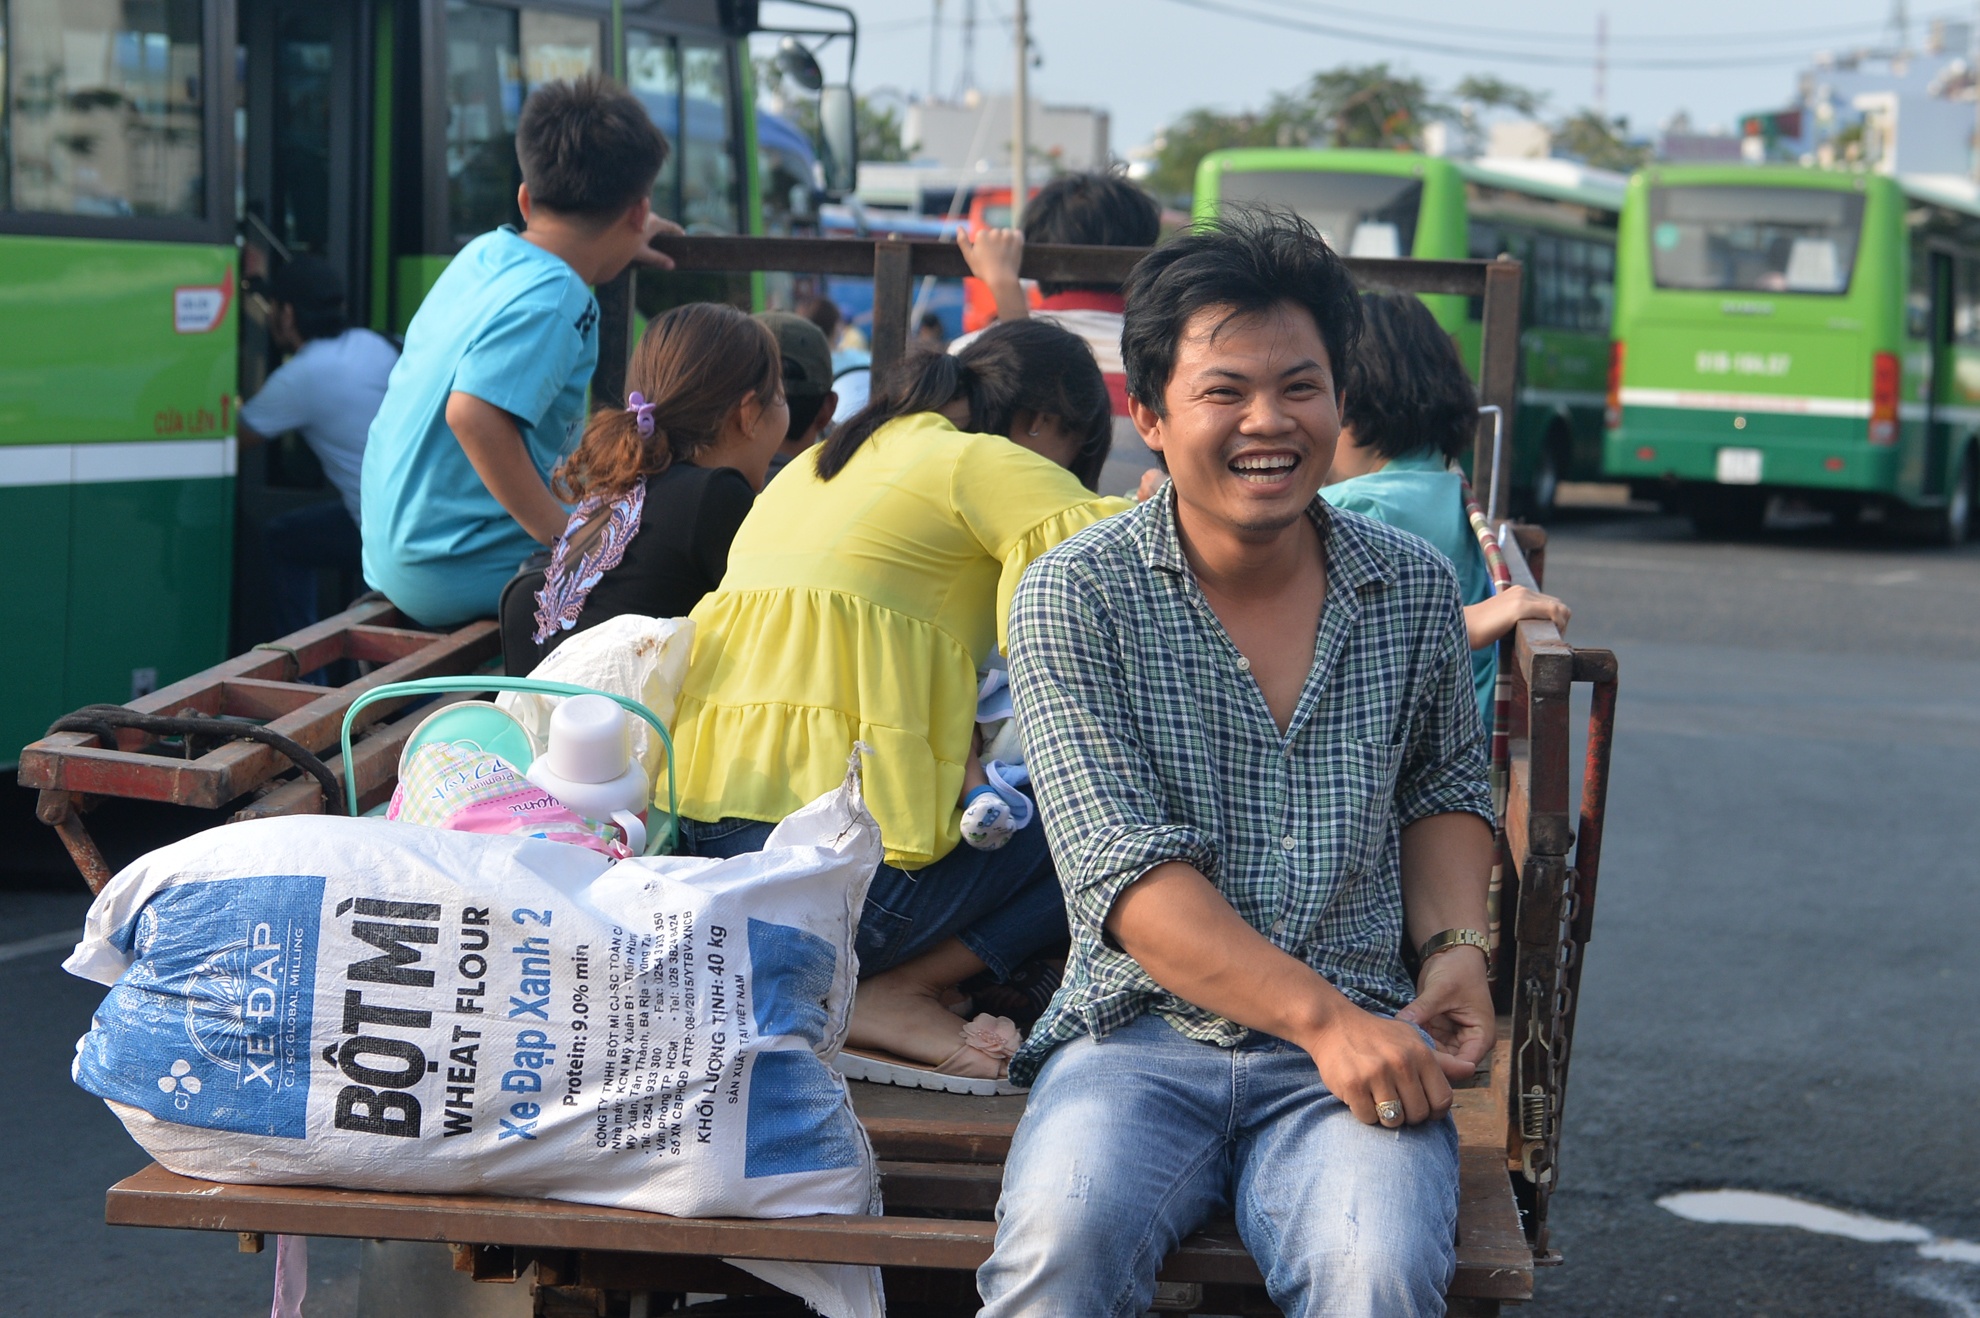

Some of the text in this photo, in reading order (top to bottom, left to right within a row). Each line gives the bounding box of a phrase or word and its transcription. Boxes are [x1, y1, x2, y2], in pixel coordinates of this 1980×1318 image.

[466, 772, 514, 792] Premium
[654, 912, 664, 931] 350
[608, 938, 622, 970] TOÀN
[654, 958, 663, 984] 0254
[669, 968, 678, 988] 028
[244, 922, 284, 1088] XE ĐẠP
[609, 974, 619, 1011] CJ-SC
[625, 995, 634, 1009] B1
[640, 989, 651, 1007] Rịa
[670, 992, 679, 1012] Tel:
[285, 928, 303, 1088] CJ-SC GLOBAL MILLING
[322, 897, 441, 1138] BỘT MÌ
[640, 1012, 648, 1027] Bà
[443, 906, 490, 1137] WHEAT FLOUR
[499, 908, 556, 1141] Xe Đạp Xanh 2
[563, 945, 589, 1106] Protein: 9.0% min
[607, 1015, 619, 1028] MÌ
[624, 1014, 634, 1044] Xuân
[606, 1032, 619, 1057] BỘT
[695, 925, 727, 1144] KHỐI LƯỢNG TỊNH: 40 kg
[726, 974, 750, 1104] SẢN XUẤT TẠI VIỆT NAM
[621, 1048, 634, 1064] Mỹ
[635, 1031, 650, 1071] Thành,
[650, 1048, 662, 1068] 300
[682, 1033, 695, 1067] ATTP:
[602, 1062, 615, 1094] TNHH
[616, 1069, 629, 1094] KCN
[629, 1075, 642, 1097] Tân
[645, 1072, 658, 1092] 933
[661, 1074, 673, 1091] TP.
[174, 1091, 189, 1110] CJ
[598, 1098, 607, 1112] TY
[612, 1098, 624, 1124] máy:
[658, 1094, 671, 1129] phòng
[628, 1100, 639, 1130] Xuân,
[642, 1104, 652, 1129] 0254
[594, 1115, 608, 1148] CÔNG
[627, 1134, 637, 1149] Mỹ
[642, 1134, 651, 1148] Tel:
[671, 1124, 680, 1137] XN
[670, 1139, 680, 1155] Số
